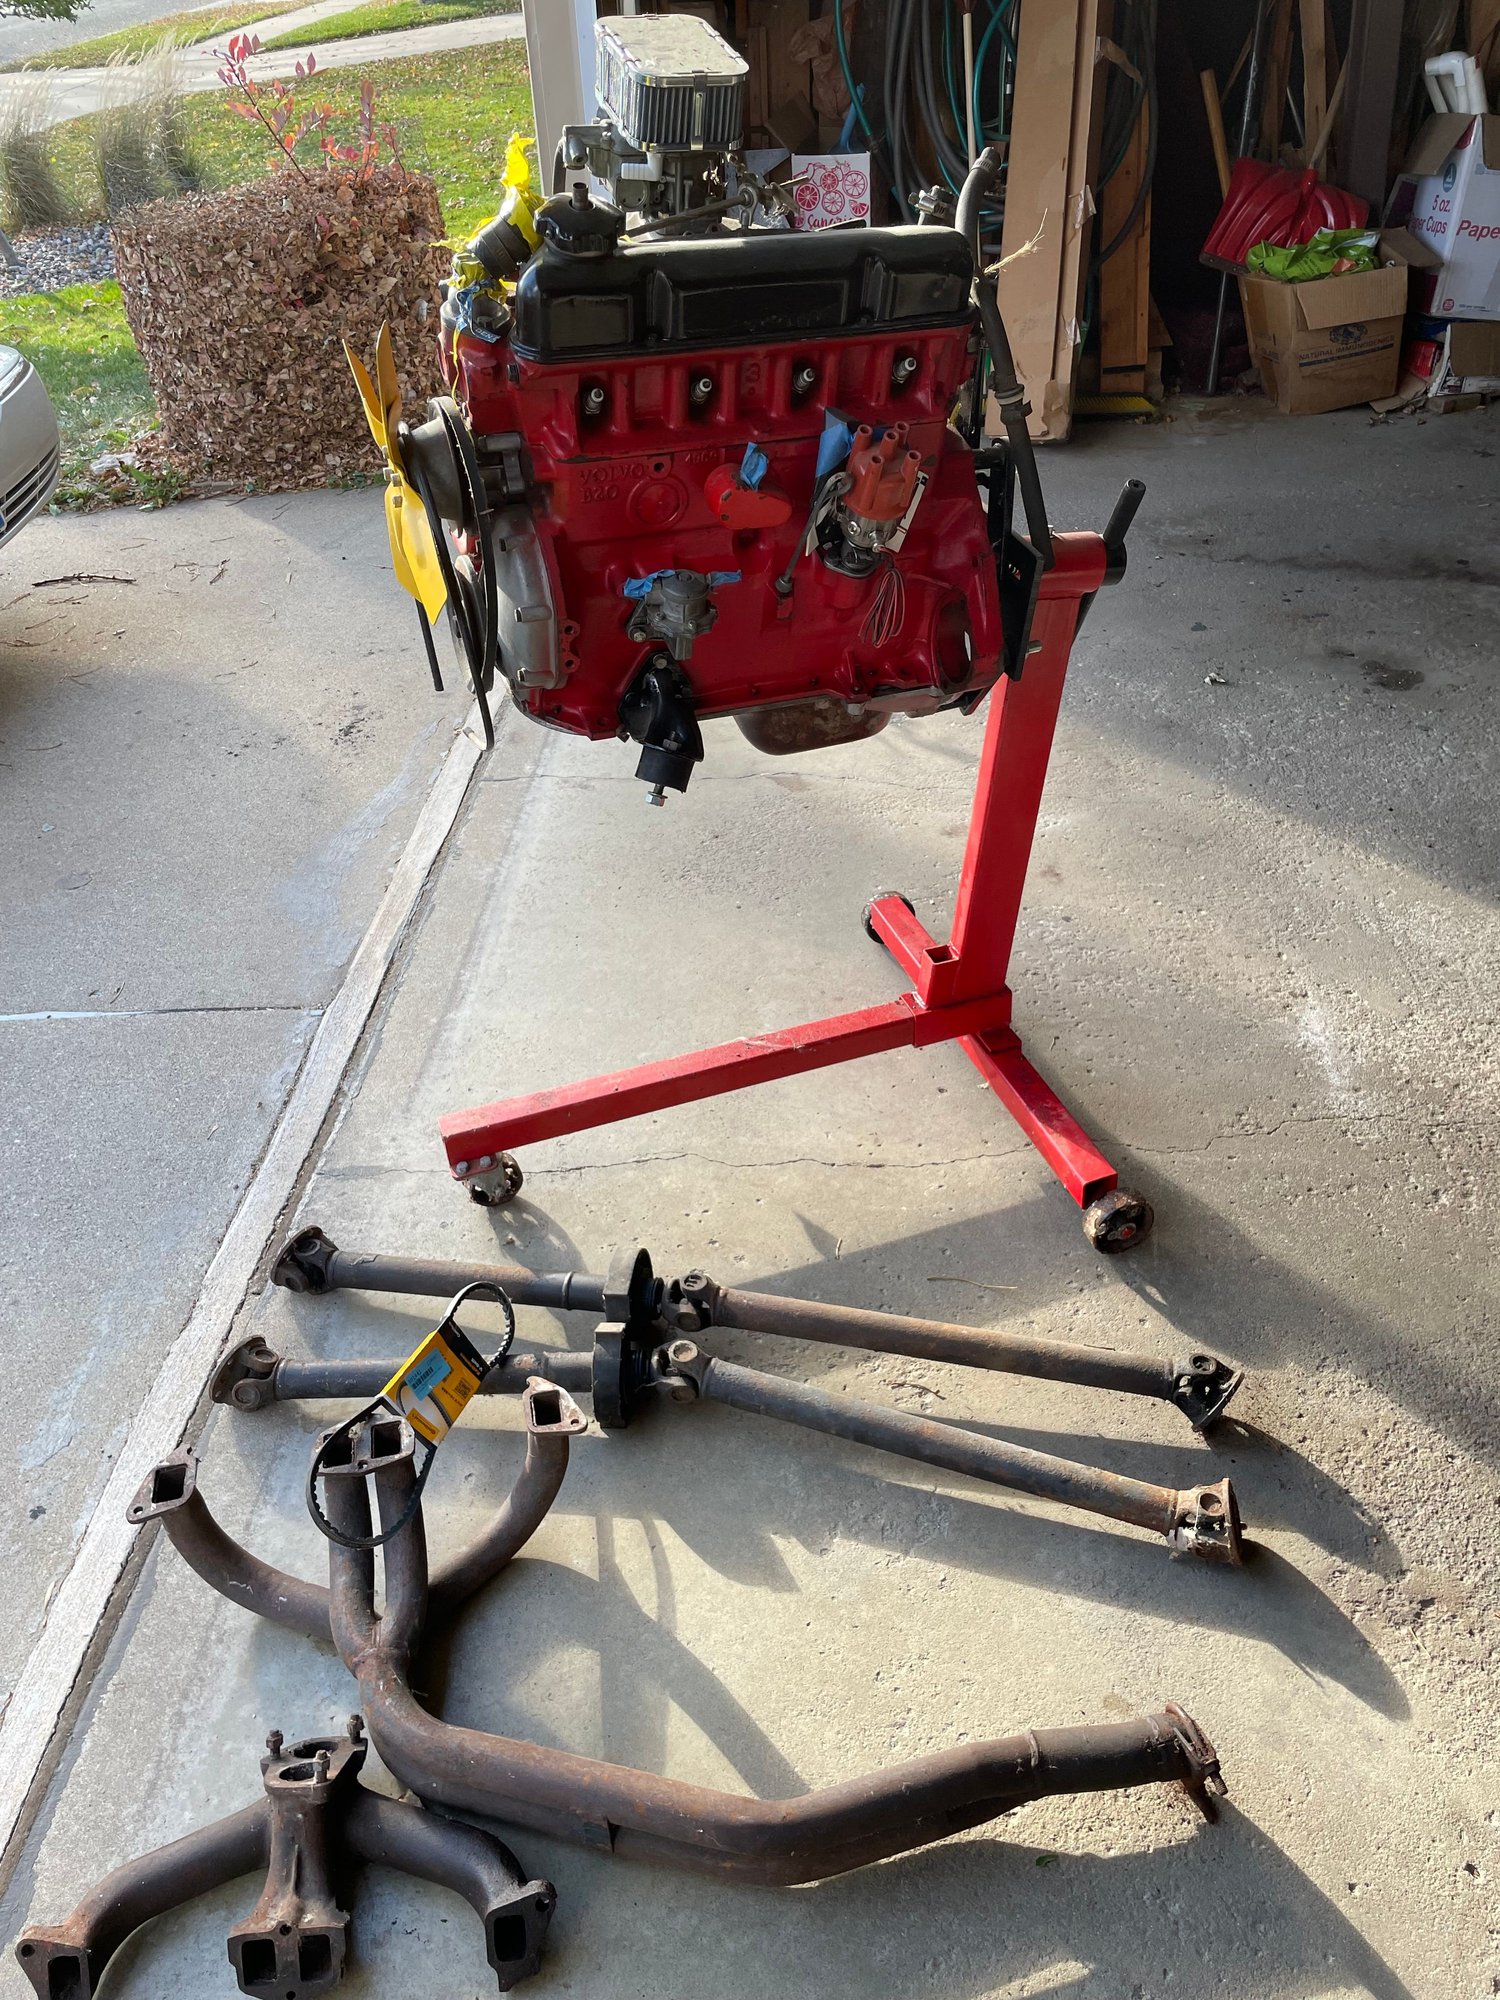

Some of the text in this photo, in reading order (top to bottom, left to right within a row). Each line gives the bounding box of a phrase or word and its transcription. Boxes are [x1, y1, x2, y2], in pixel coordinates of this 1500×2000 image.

[1431, 194, 1451, 213] 5 oz.
[1426, 215, 1448, 238] Cups
[1297, 348, 1333, 361] NATURAL
[580, 463, 645, 485] VOLVO
[581, 484, 618, 503] B20
